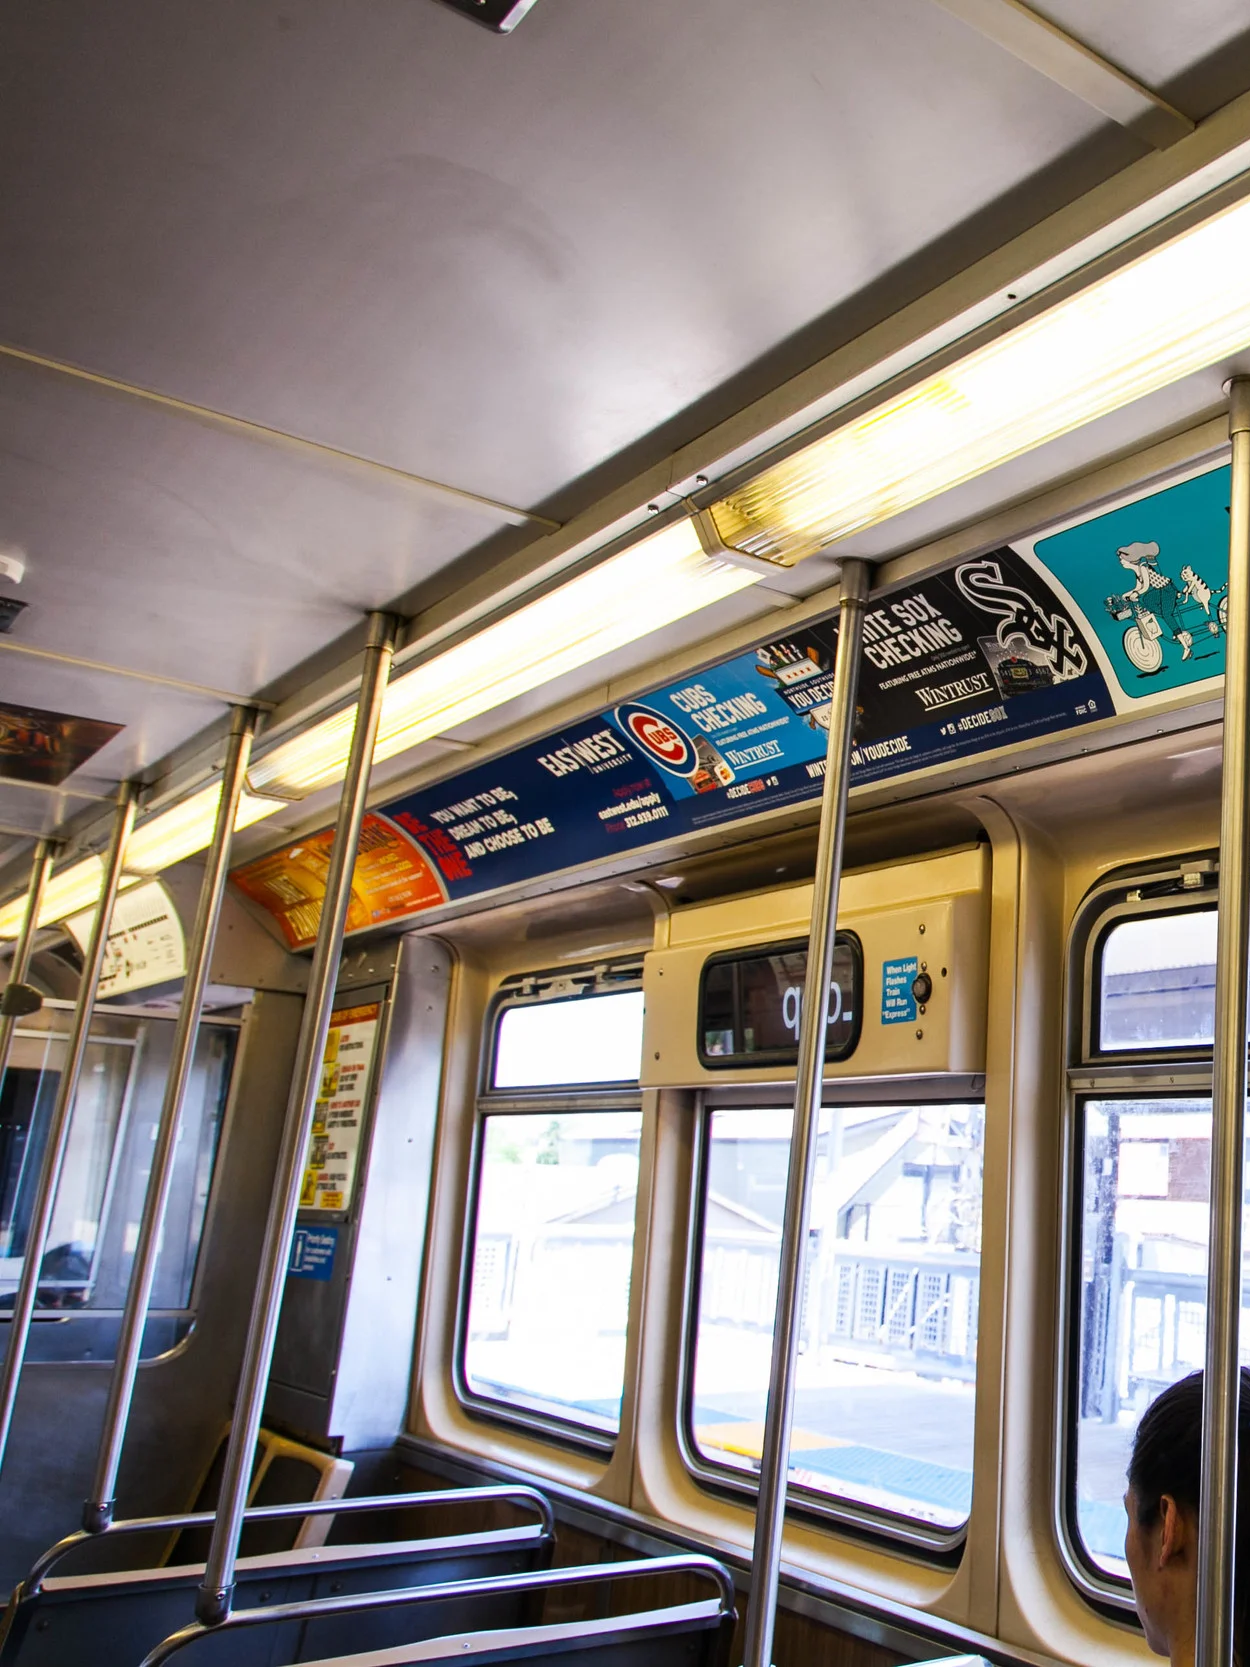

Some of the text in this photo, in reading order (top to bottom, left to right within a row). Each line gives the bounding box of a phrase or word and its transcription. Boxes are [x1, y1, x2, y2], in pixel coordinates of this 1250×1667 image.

[833, 593, 942, 644] ITE SOX
[864, 618, 963, 670] CHECKING
[879, 674, 910, 691] FEATURING
[907, 671, 922, 681] FREE
[669, 684, 717, 713] CUBS
[788, 690, 812, 709] YOU
[691, 692, 767, 733] CHECKING
[592, 753, 633, 774] UNIVERSITY
[430, 786, 518, 824] YOU WANT TO BE,
[447, 809, 518, 841] DREAM TO BE,
[464, 817, 555, 860] AND CHOOSE TO BE
[886, 962, 917, 975] When Light
[886, 976, 907, 986] Flashes
[885, 998, 908, 1008] Will Run
[886, 987, 900, 996] Train
